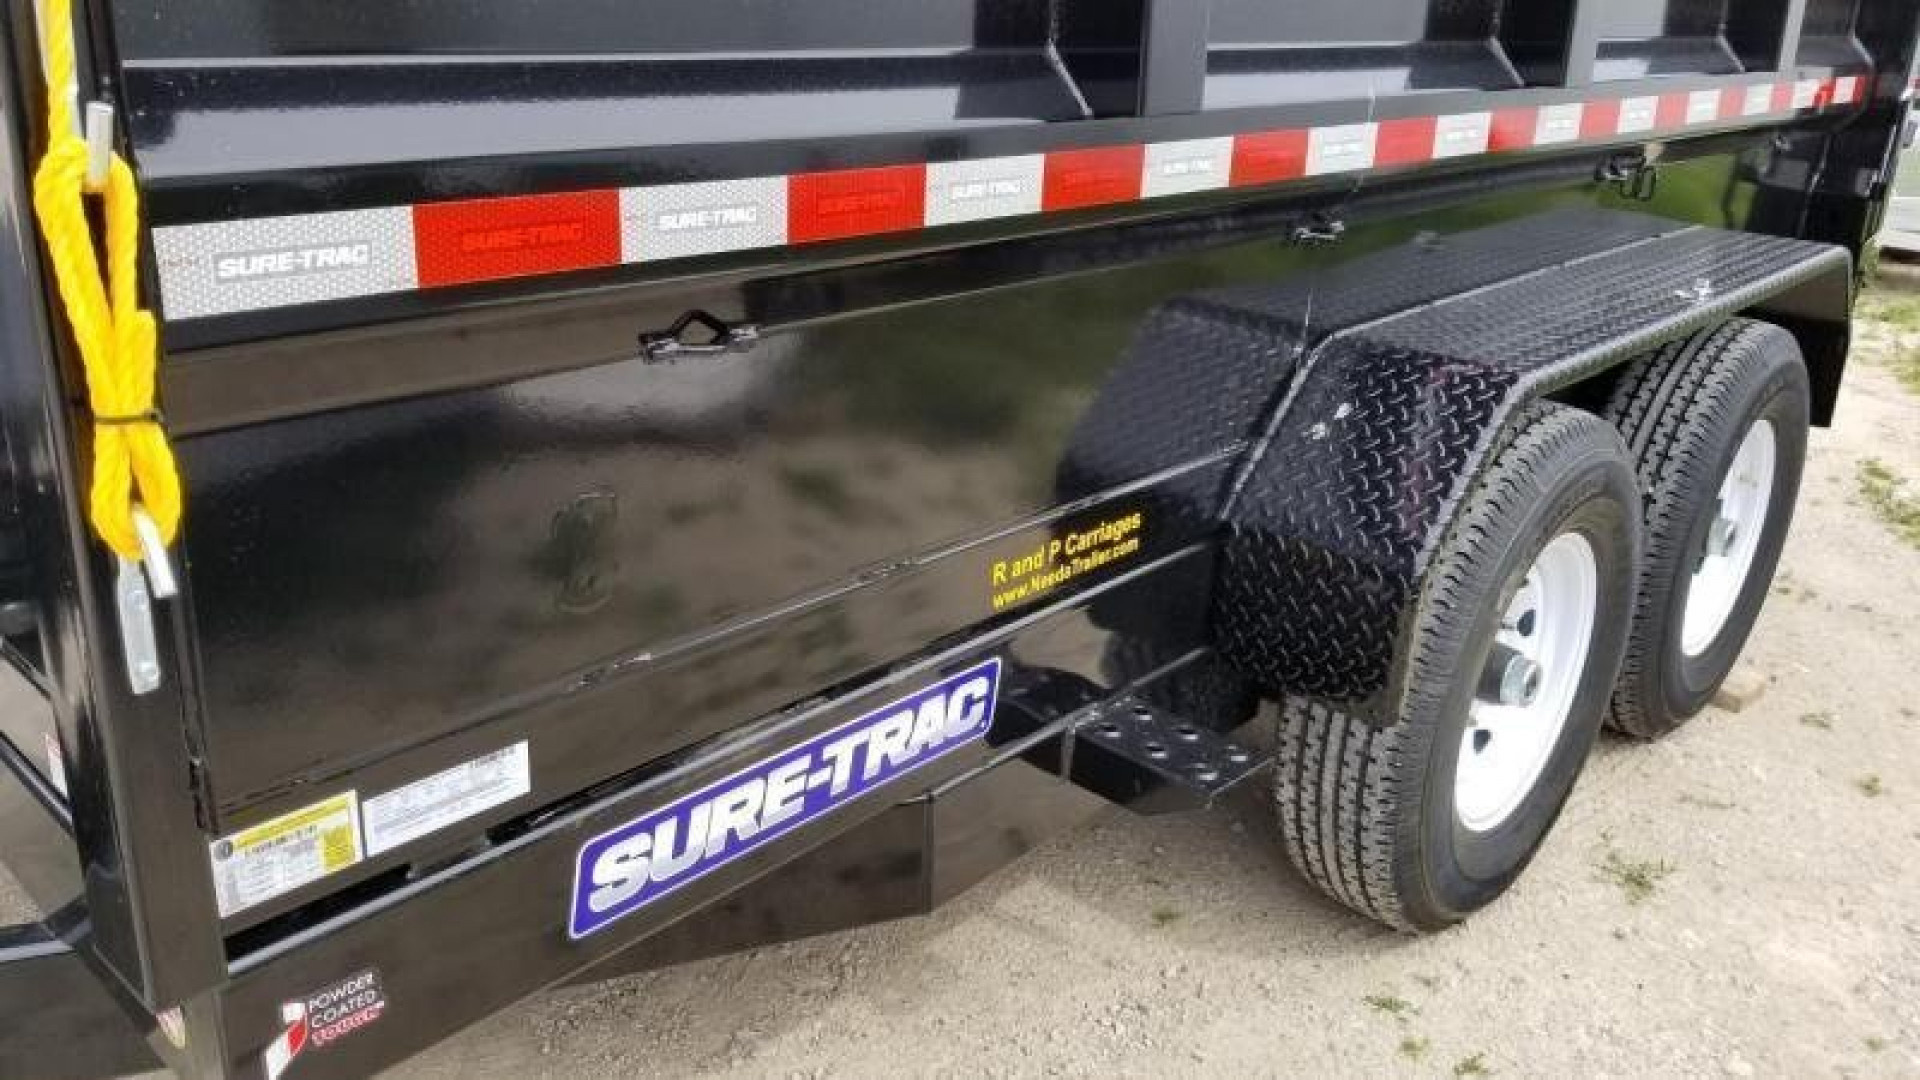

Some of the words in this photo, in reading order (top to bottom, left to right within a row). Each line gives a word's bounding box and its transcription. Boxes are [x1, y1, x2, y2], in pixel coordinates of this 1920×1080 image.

[217, 244, 369, 278] SURE-TRAC
[993, 560, 1007, 586] R
[1012, 544, 1045, 577] and
[1049, 539, 1062, 562] P
[1065, 513, 1141, 555] Carriages
[588, 675, 989, 914] SURE-TRAC
[309, 971, 373, 1014] POWDER
[311, 990, 376, 1028] COATED
